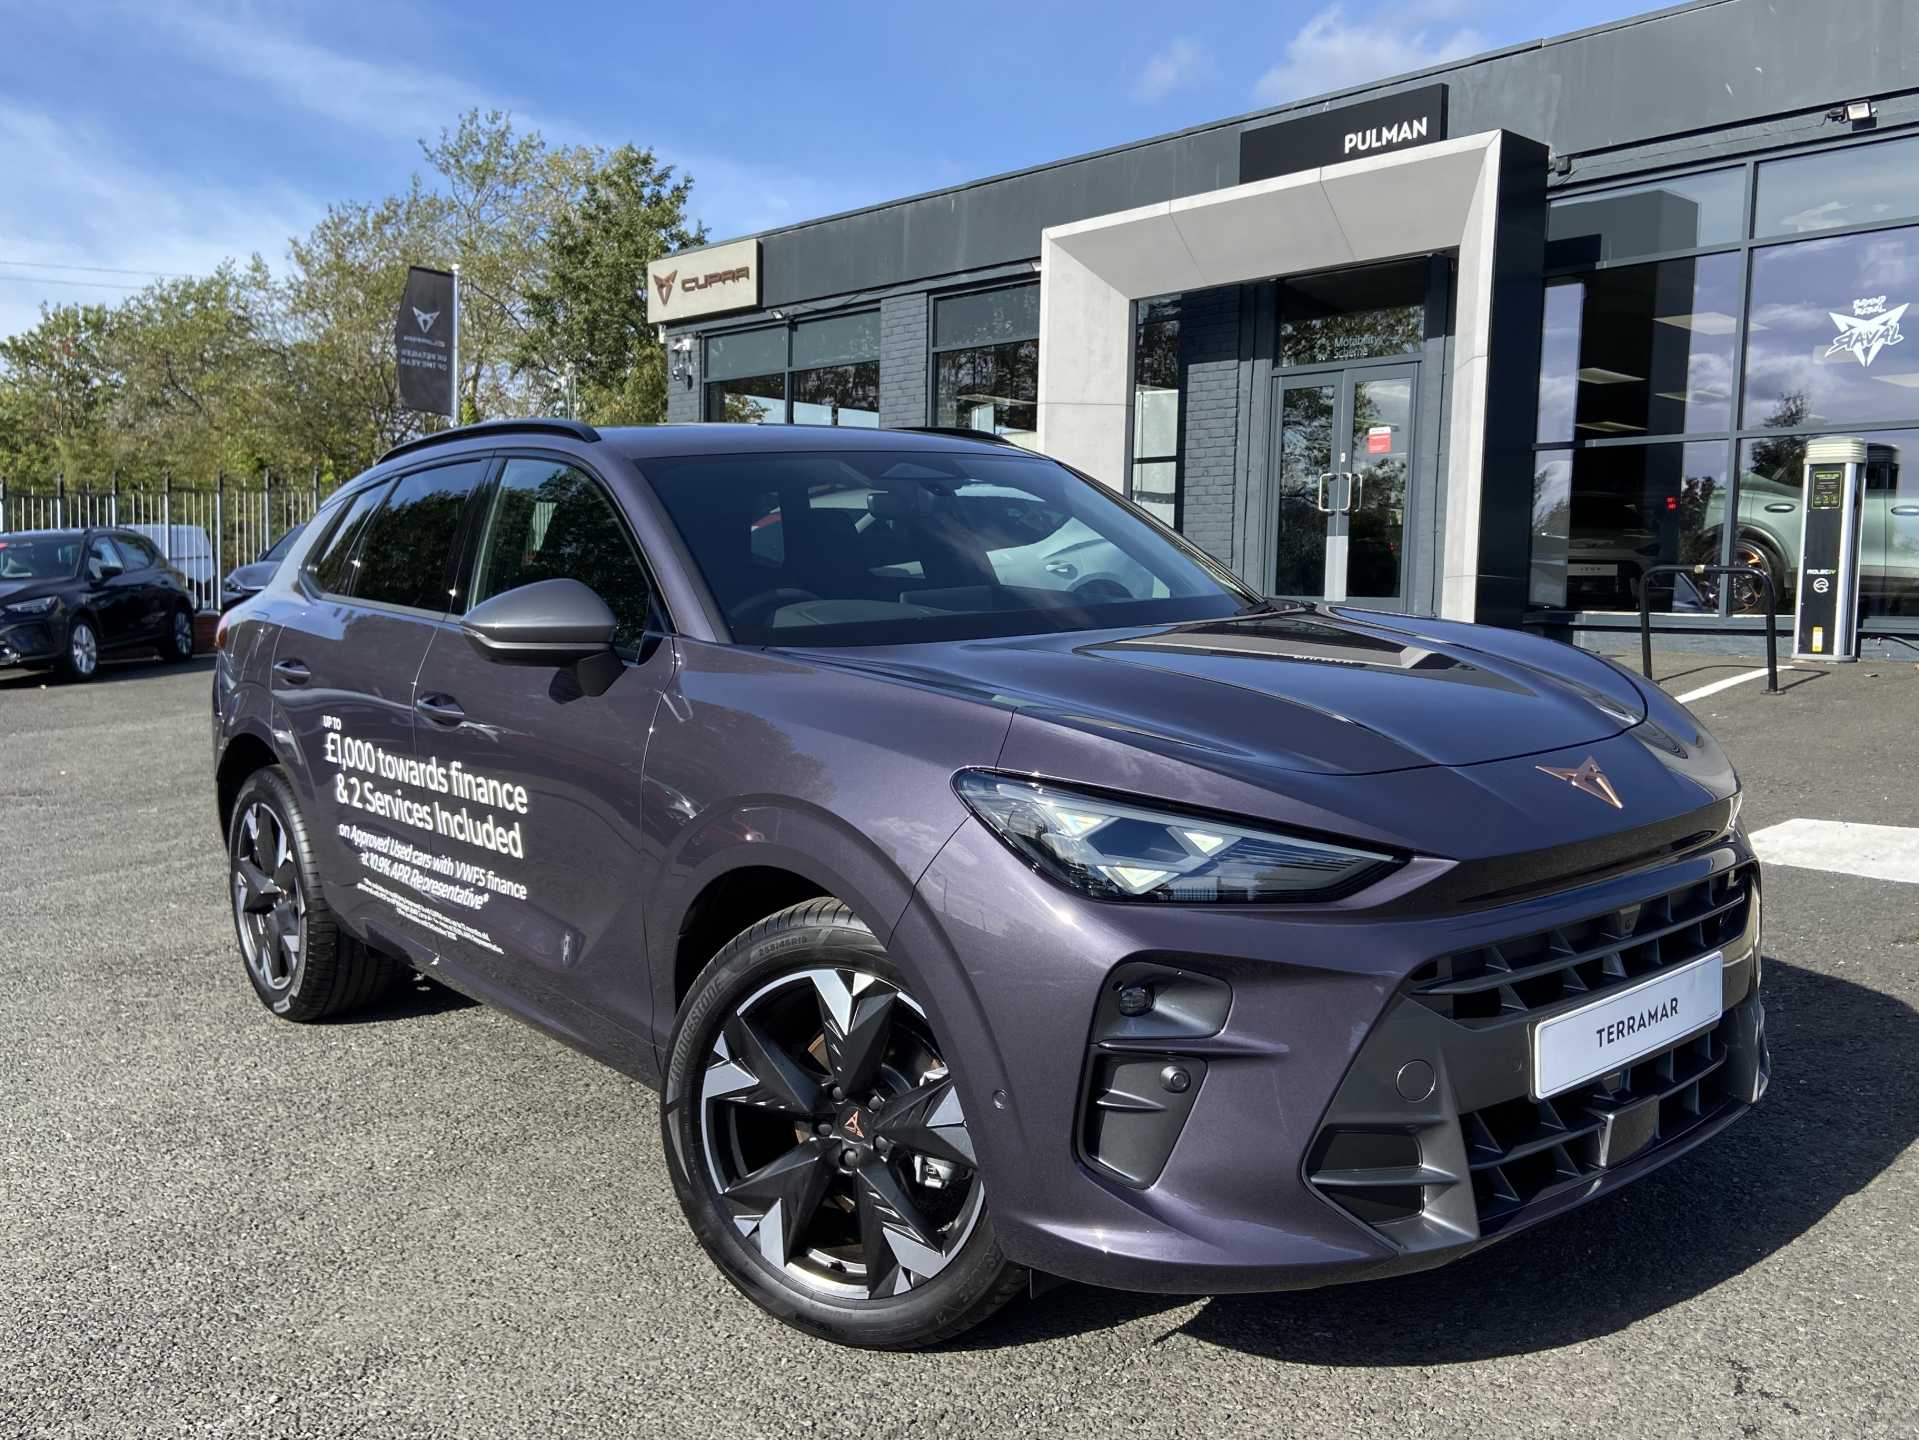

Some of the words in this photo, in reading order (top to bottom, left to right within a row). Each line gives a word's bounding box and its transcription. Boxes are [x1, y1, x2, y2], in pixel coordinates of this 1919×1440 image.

[1344, 116, 1428, 154] PULMAN
[681, 266, 750, 292] CUPRA
[324, 732, 375, 774] £1,000
[377, 748, 448, 794] towards
[449, 760, 528, 815] finance
[336, 772, 349, 805] &
[349, 777, 363, 809] 2
[363, 781, 433, 831] Services
[434, 801, 524, 859] Included
[338, 823, 350, 838] on
[350, 825, 390, 853] Approved
[389, 838, 413, 862] Used
[412, 850, 433, 869] cars
[432, 854, 454, 876] with
[456, 860, 486, 887] VWFS
[486, 870, 528, 900] finance
[360, 851, 369, 867] at
[390, 861, 411, 885] APR
[1595, 997, 1679, 1048] TERRAMAR
